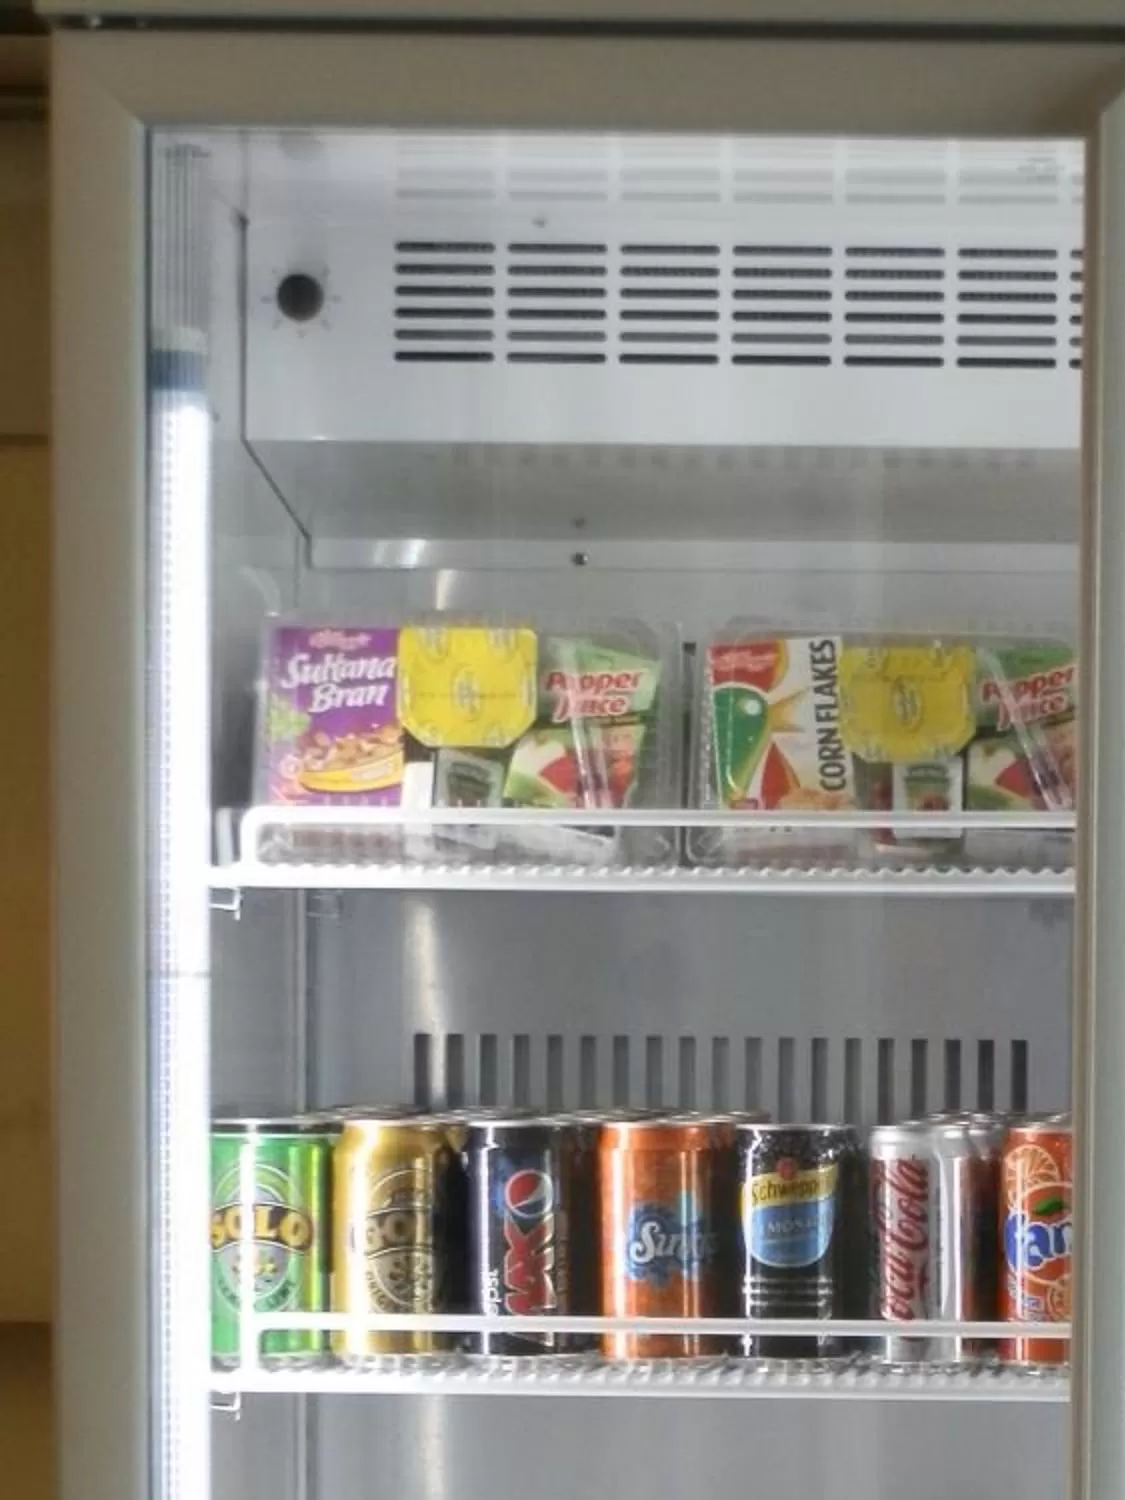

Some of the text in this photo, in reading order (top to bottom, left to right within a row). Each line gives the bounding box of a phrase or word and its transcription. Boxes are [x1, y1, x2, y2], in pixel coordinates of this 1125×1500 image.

[280, 652, 396, 689] Sultana
[308, 683, 388, 713] Bran
[809, 639, 846, 791] CORN FLAKES
